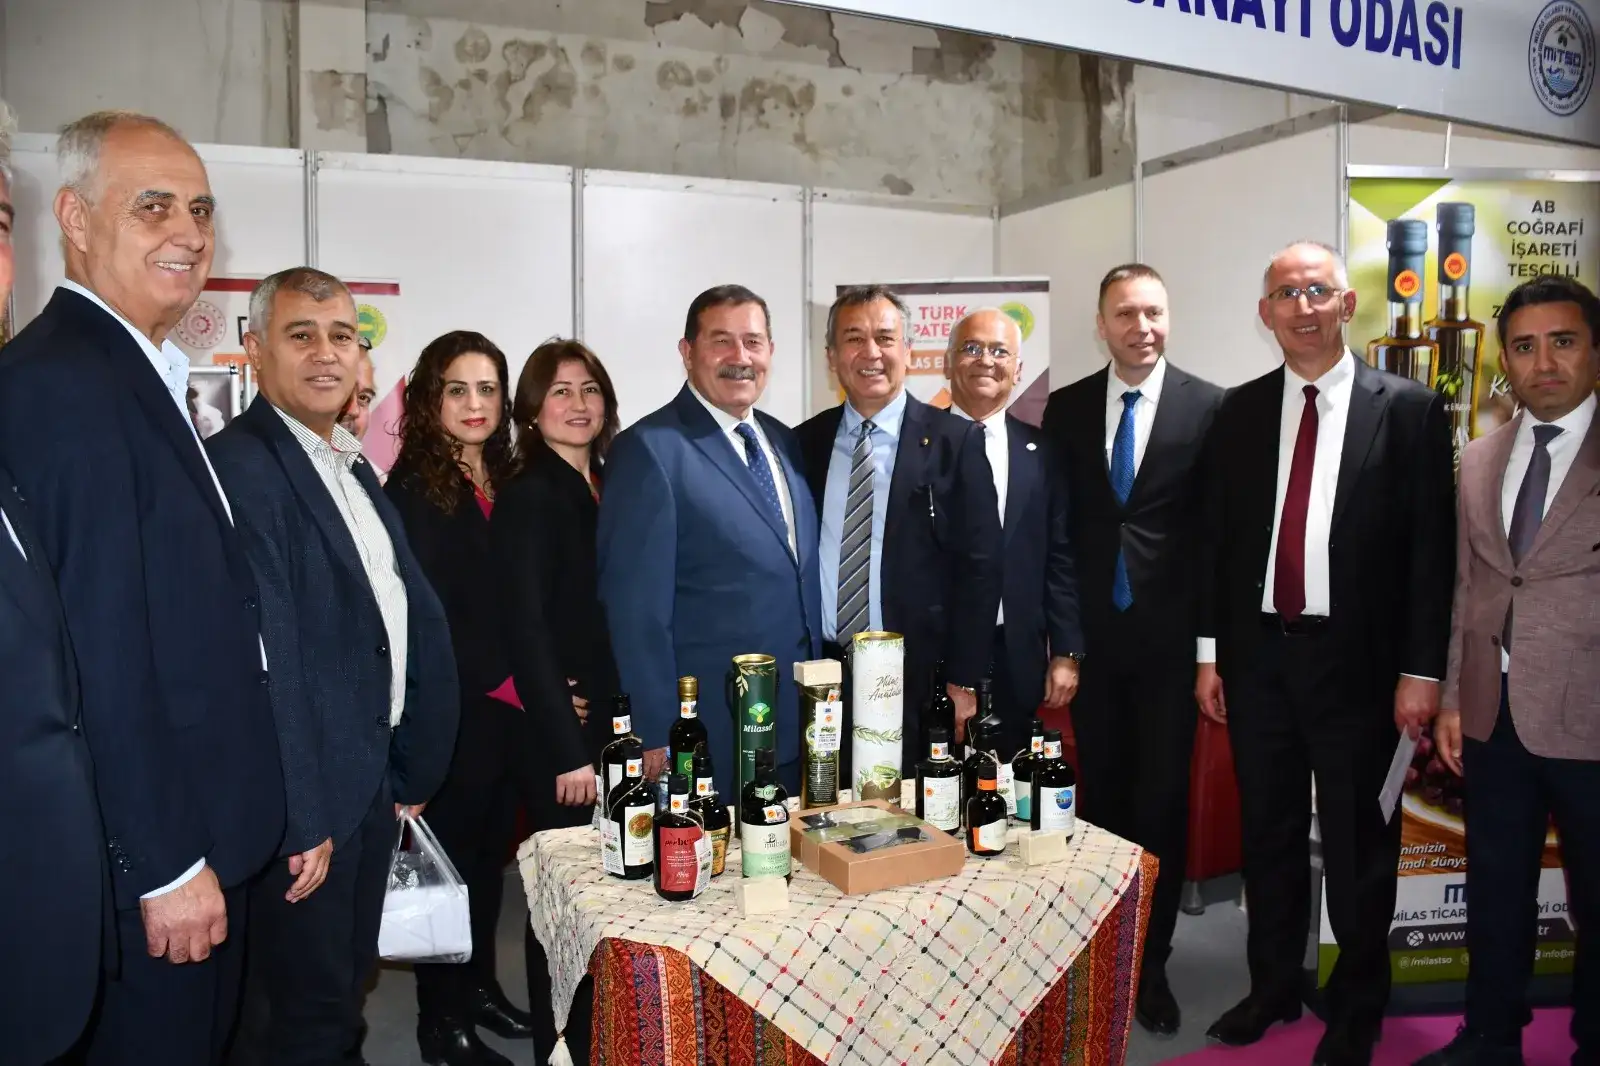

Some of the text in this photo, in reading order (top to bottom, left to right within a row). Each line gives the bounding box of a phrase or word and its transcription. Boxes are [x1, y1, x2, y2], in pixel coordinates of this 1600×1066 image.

[1330, 0, 1462, 69] ODASI
[1531, 200, 1555, 213] AB
[1507, 218, 1584, 235] COĞRAFİ
[1511, 239, 1577, 259] İŞARETİ
[1507, 261, 1580, 278] TESCİLLİ
[1400, 842, 1446, 855] nimizin
[1431, 906, 1466, 919] TİCAR
